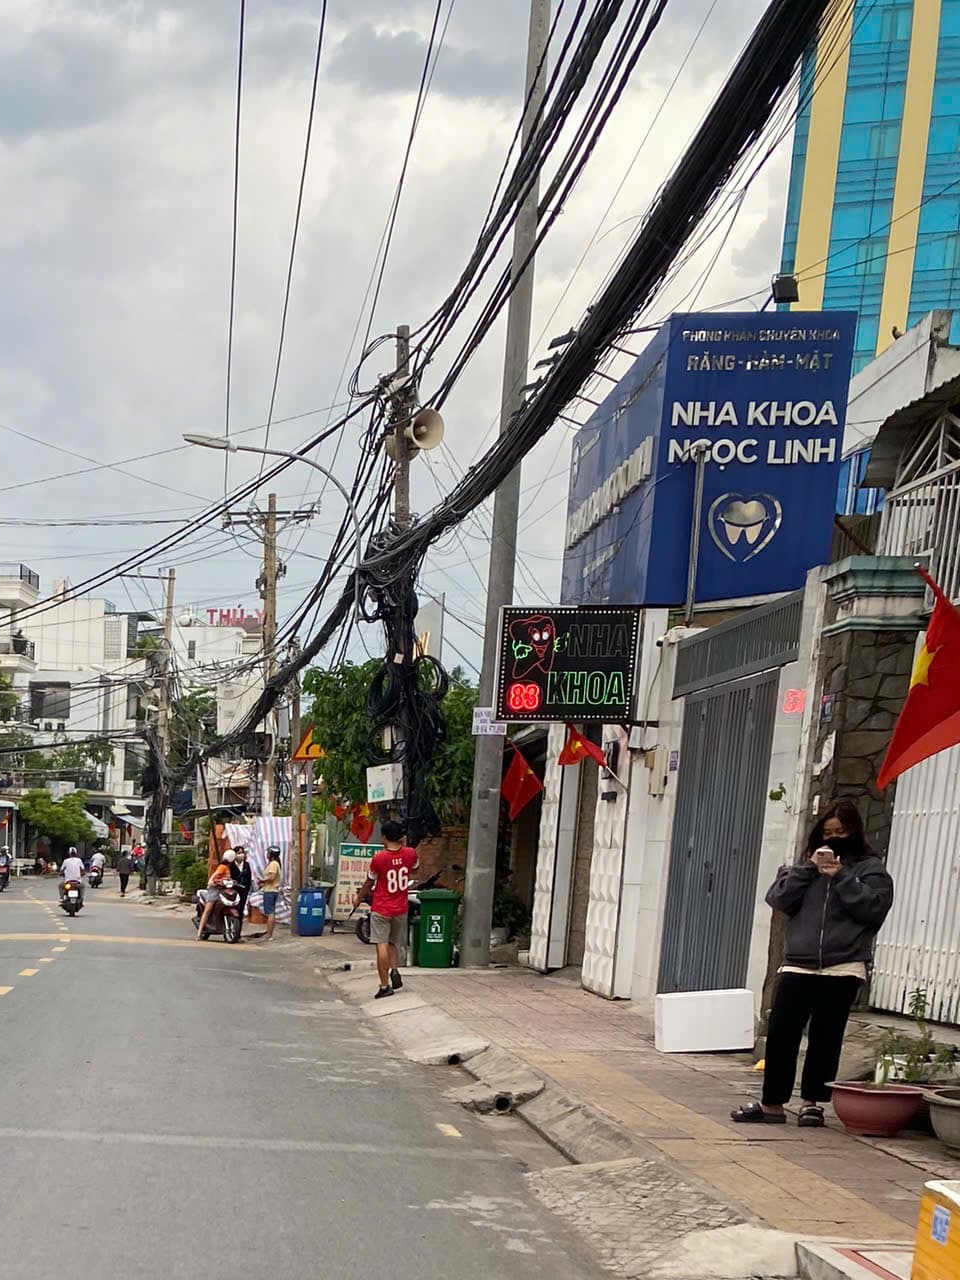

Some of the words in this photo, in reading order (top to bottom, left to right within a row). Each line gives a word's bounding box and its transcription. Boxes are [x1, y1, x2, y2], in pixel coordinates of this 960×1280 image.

[671, 400, 738, 427] NHA
[746, 400, 839, 427] KHOA
[767, 438, 837, 465] LINH
[567, 623, 630, 658] NHA
[510, 683, 540, 710] 83
[546, 671, 626, 705] KHOA
[386, 866, 409, 894] 86
